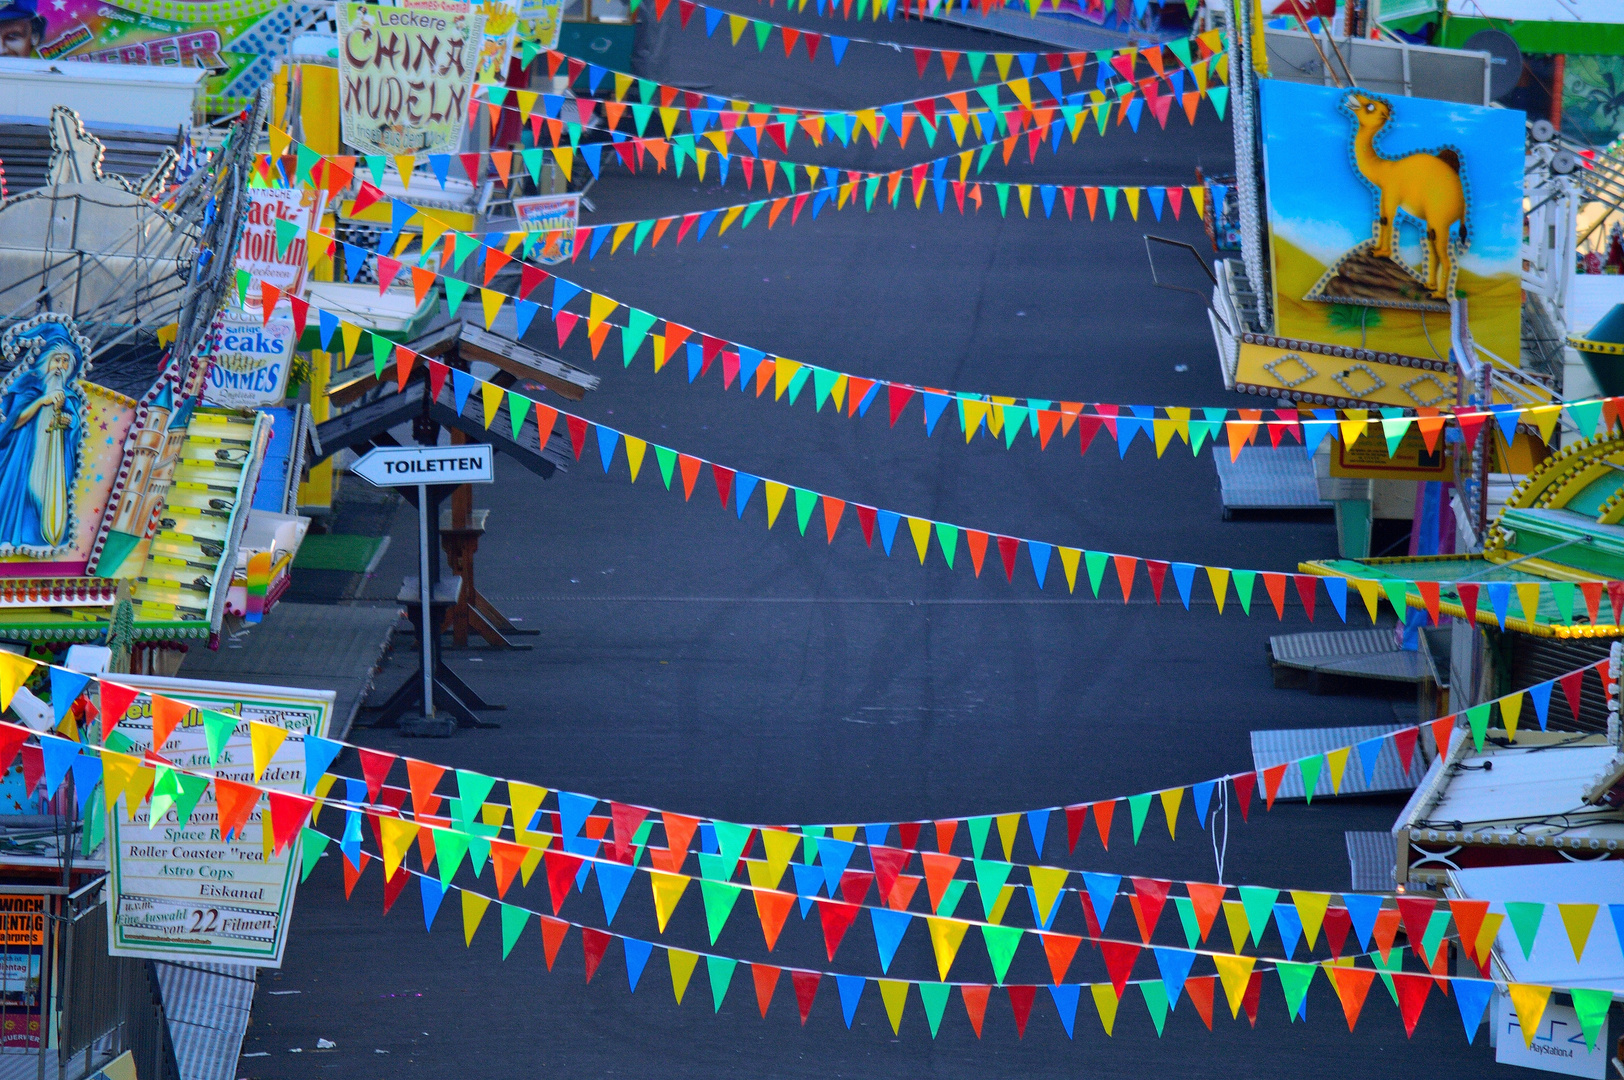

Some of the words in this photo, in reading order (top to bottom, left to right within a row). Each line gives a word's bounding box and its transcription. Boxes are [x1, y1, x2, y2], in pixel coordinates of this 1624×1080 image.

[377, 11, 447, 31] Leckere
[345, 27, 466, 78] CHINA
[344, 75, 466, 124] NUDELN
[226, 326, 261, 335] Saftige
[211, 363, 281, 393] OMMES
[384, 457, 483, 474] TOILETTEN
[284, 712, 318, 731] Real!
[164, 828, 205, 842] Space
[129, 845, 168, 859] Roller
[172, 847, 225, 860] Coaster
[230, 848, 275, 861] "rea"
[159, 864, 194, 877] Astro
[199, 865, 234, 881] Cops
[200, 884, 265, 900] Eiskanal
[117, 913, 142, 926] Eine
[142, 909, 187, 924] Auswahl
[162, 926, 185, 935] von
[190, 909, 219, 933] 22
[222, 915, 279, 932] Filmen!
